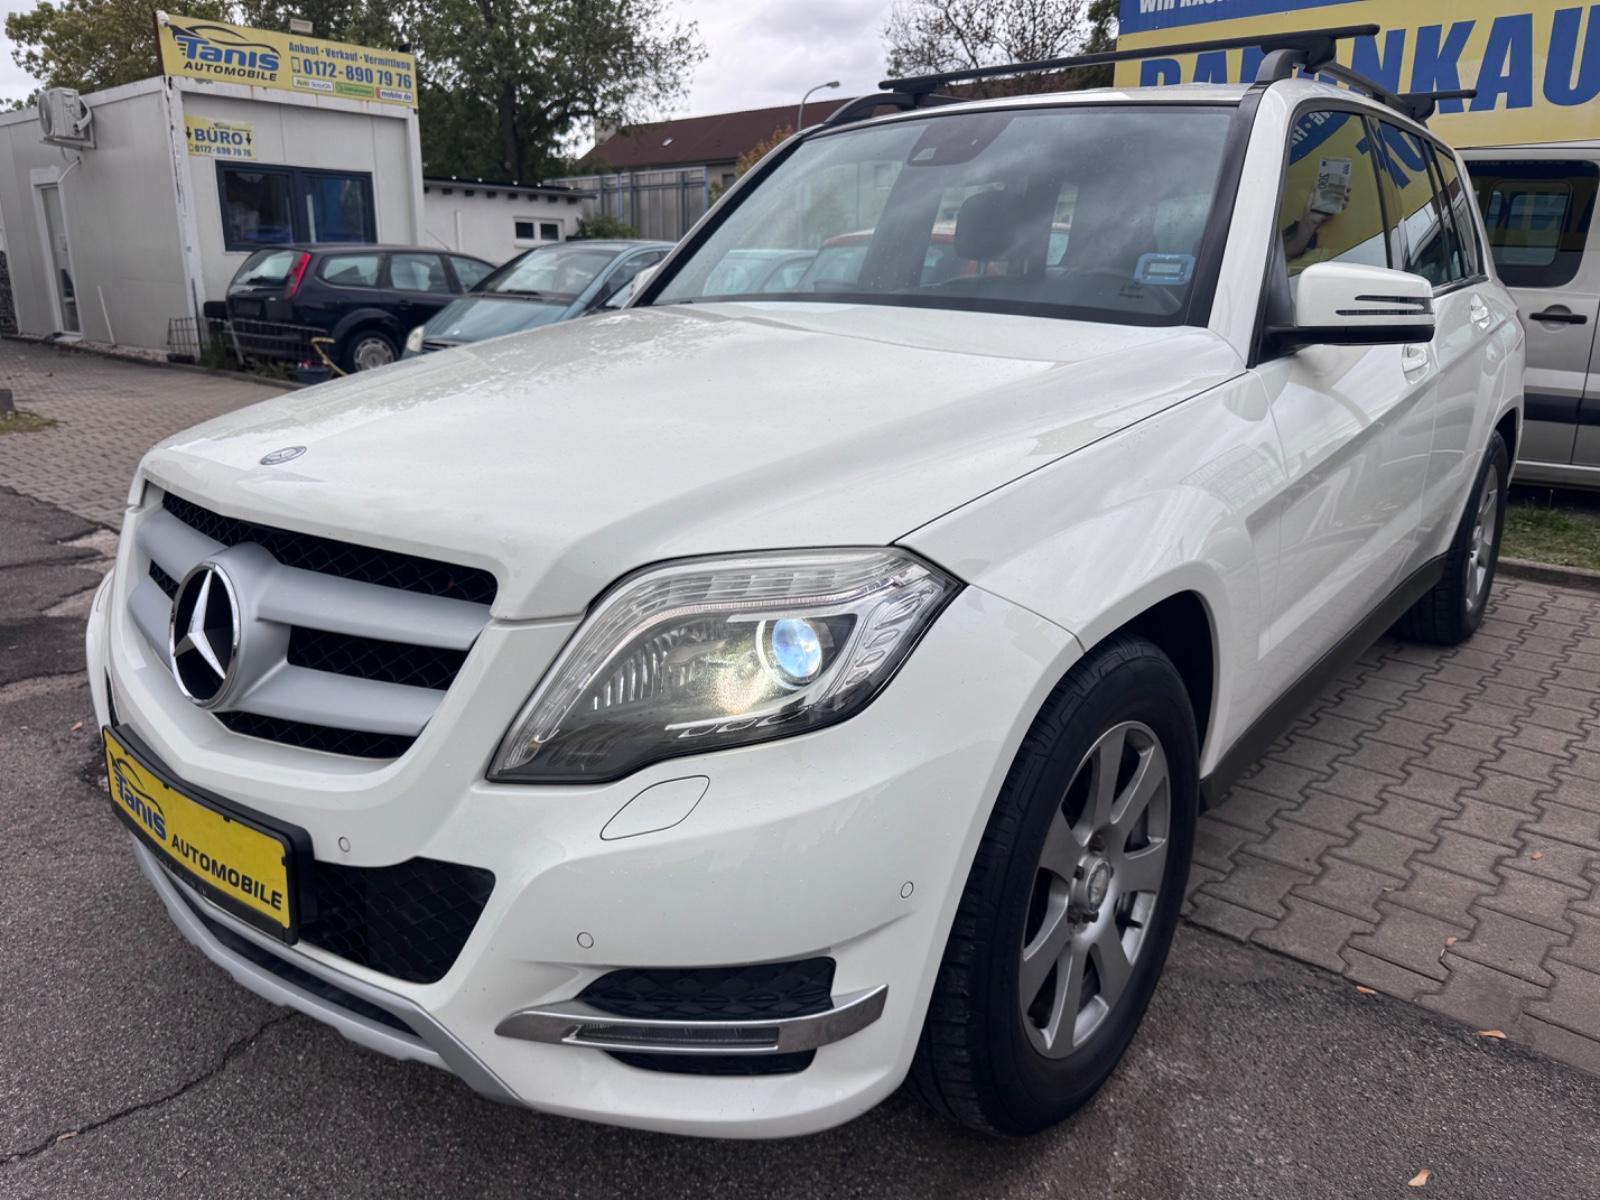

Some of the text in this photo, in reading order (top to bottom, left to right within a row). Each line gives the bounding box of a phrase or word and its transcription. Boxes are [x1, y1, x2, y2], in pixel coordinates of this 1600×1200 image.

[176, 36, 280, 71] Tanis
[288, 42, 319, 55] Ankauf
[325, 48, 358, 62] Verkauf
[184, 61, 277, 81] AUTOMOBILE
[194, 127, 243, 145] BÜRO
[116, 775, 167, 841] Tanis
[172, 833, 282, 911] AUTOMOBILE
